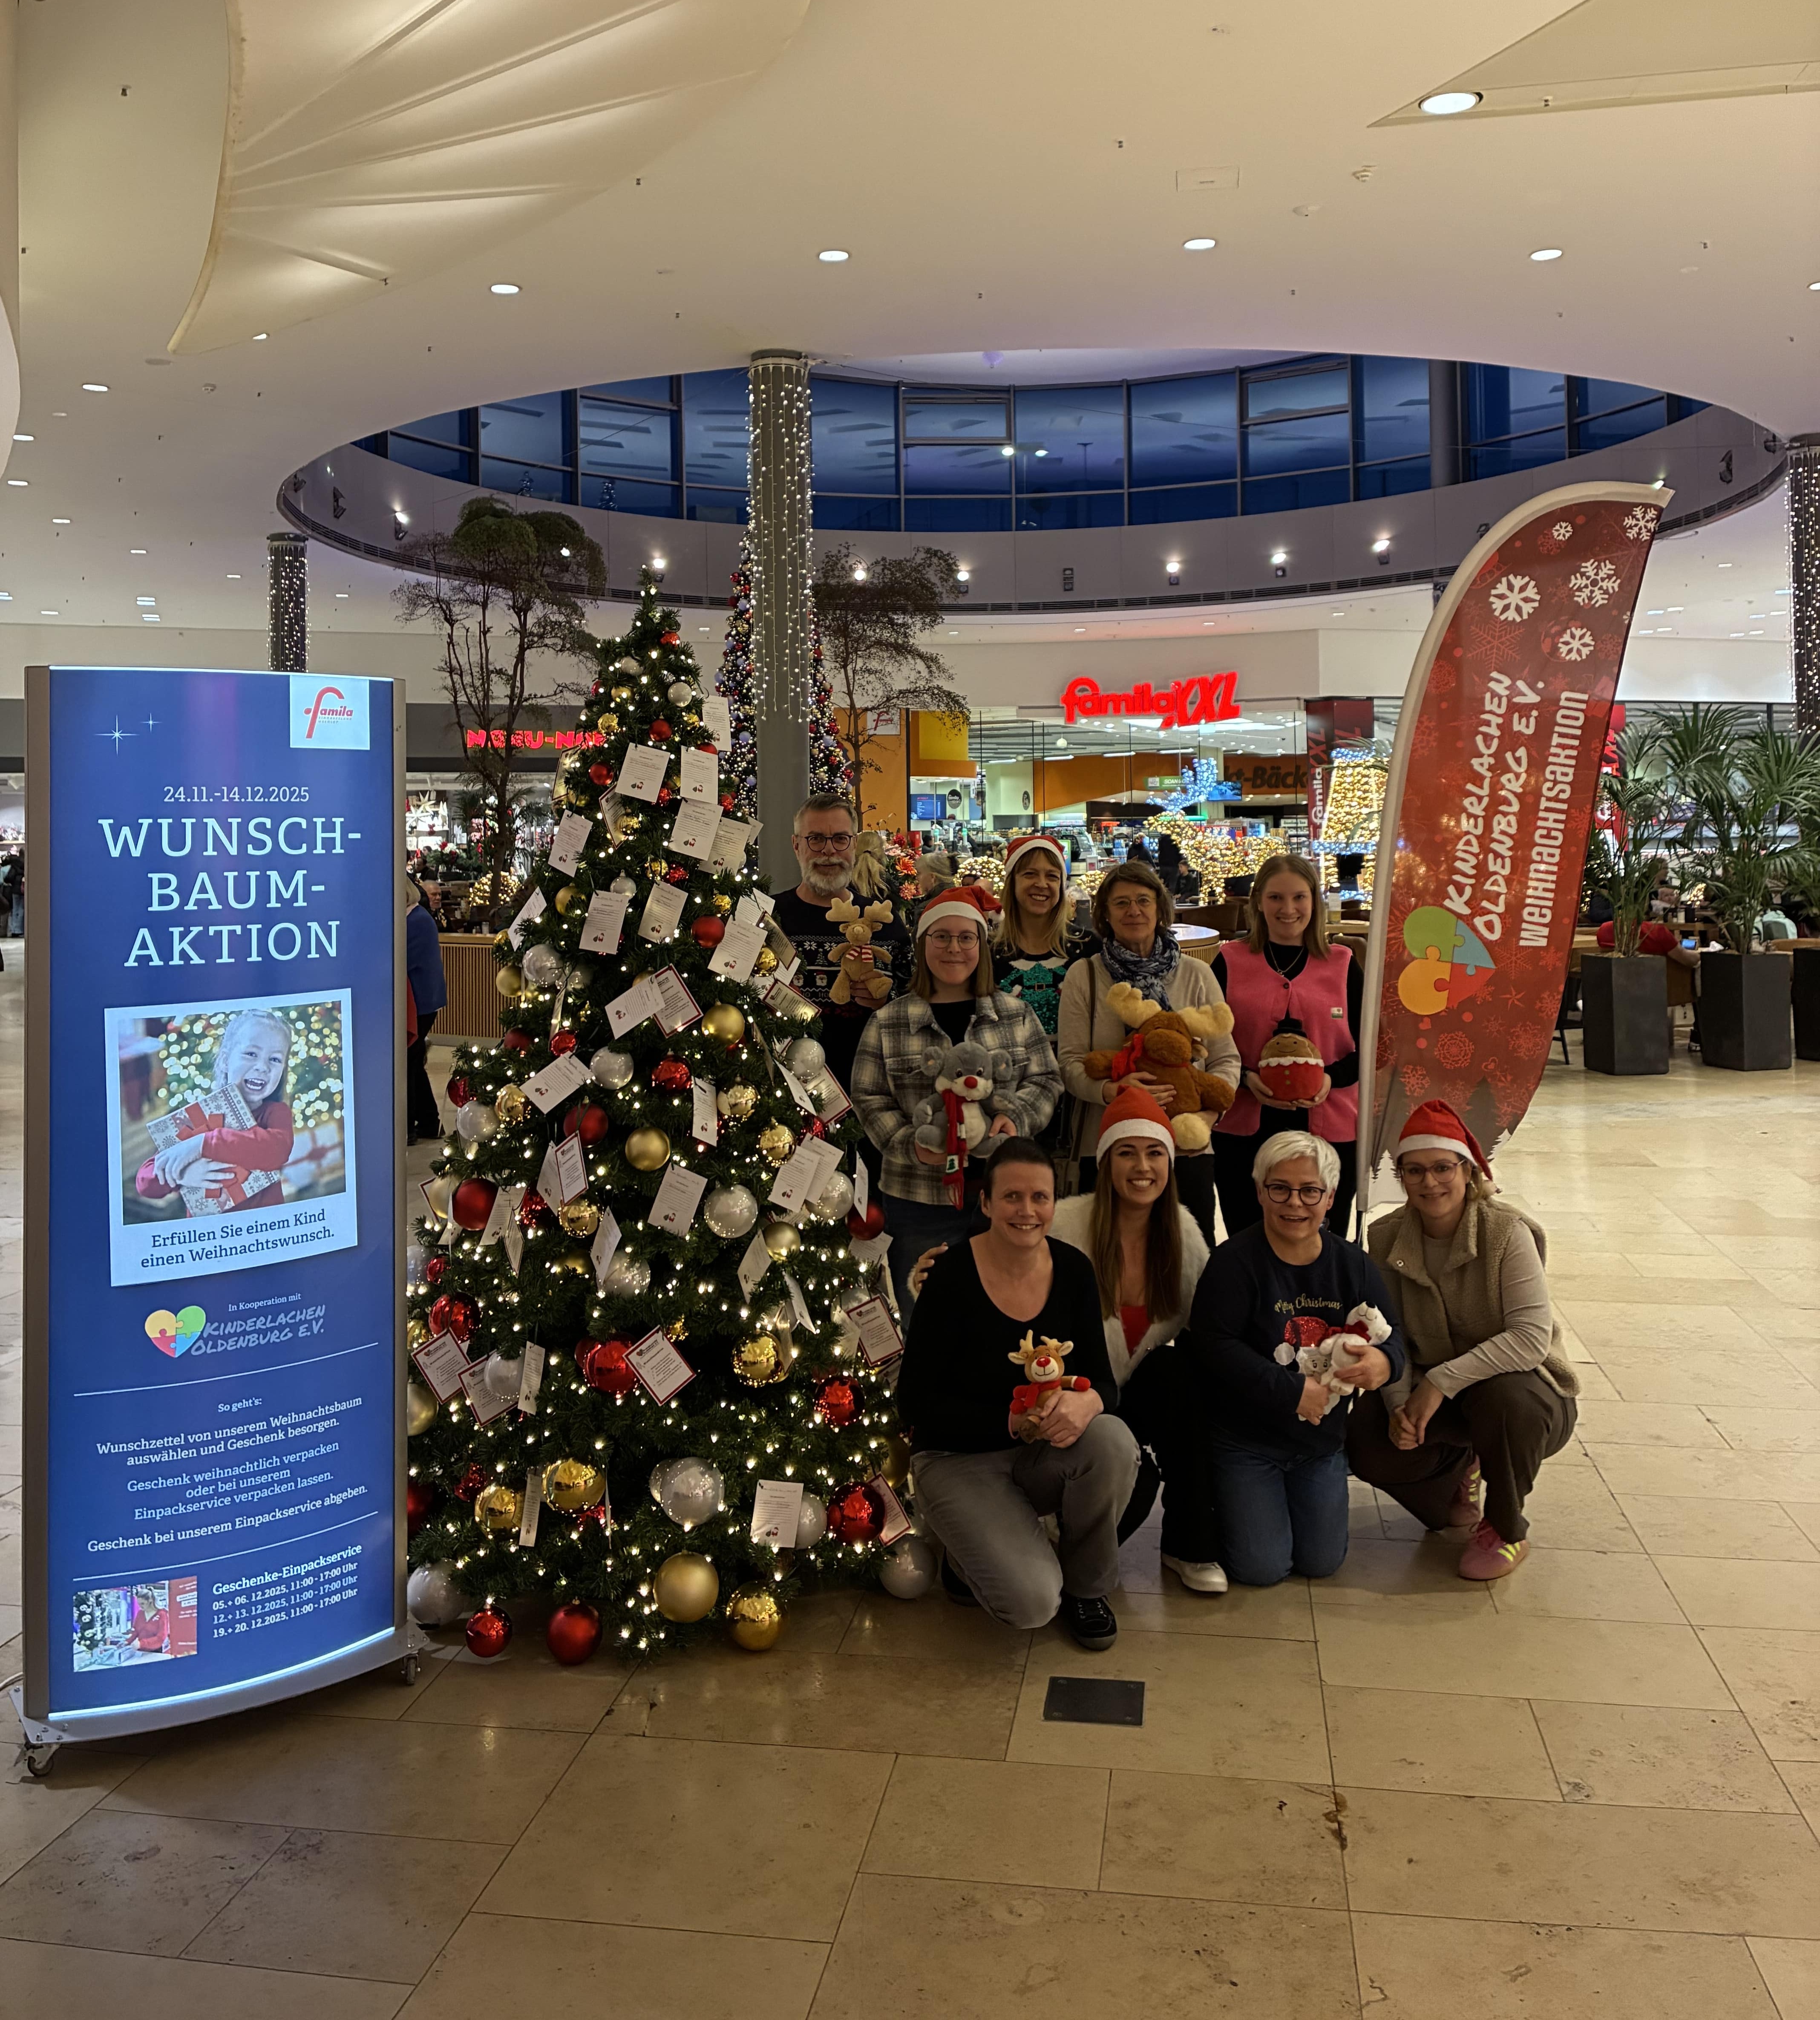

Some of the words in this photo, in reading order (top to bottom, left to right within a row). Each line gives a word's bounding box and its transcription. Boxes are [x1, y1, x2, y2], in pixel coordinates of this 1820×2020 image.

[1060, 677, 1175, 724] famila
[163, 786, 310, 803] 24.11.-14.12.2025
[1443, 671, 1512, 915] KINDERLACHEN
[1474, 746, 1528, 940] OLDENBURG
[1513, 680, 1545, 735] E.V.
[98, 816, 361, 858] WUNSCH-
[147, 870, 325, 912] BAUM-
[124, 920, 340, 967] AKTION
[141, 1253, 185, 1268] einen
[189, 1226, 335, 1262] Weihnachtswunsch.
[151, 1230, 216, 1248] Erfüllen
[220, 1224, 243, 1239] Sie
[246, 1218, 290, 1235] einem
[293, 1208, 326, 1227] Kind
[203, 1305, 325, 1338] KINDERLACHEN
[228, 1303, 238, 1311] In
[239, 1296, 287, 1311] Kooperation
[288, 1293, 302, 1302] mit
[1295, 1293, 1343, 1310] Christmas
[191, 1328, 293, 1356] OLDENBURG
[298, 1319, 324, 1337] E.V.
[96, 1433, 185, 1454] Wunschzettel
[187, 1432, 212, 1443] von
[214, 1421, 267, 1439] unserem
[269, 1397, 362, 1427] Weihnachtsbaum
[218, 1403, 230, 1412] So
[231, 1397, 262, 1412] geht's:
[127, 1448, 197, 1466] auswählen
[200, 1441, 225, 1455] und
[227, 1429, 285, 1450] Geschenk
[288, 1418, 340, 1438] besorgen.
[127, 1473, 191, 1492] Geschenk
[193, 1455, 281, 1483] weihnachtlich
[282, 1442, 340, 1462] verpacken
[186, 1485, 216, 1498] oder
[218, 1478, 237, 1492] bei
[239, 1469, 291, 1488] unserem
[134, 1496, 231, 1521] Einpackservice
[233, 1484, 295, 1503] verpacken
[297, 1472, 334, 1489] lassen.
[87, 1534, 152, 1552] Geschenk
[155, 1530, 175, 1543] bei
[177, 1522, 233, 1540] unserem
[235, 1499, 322, 1529] Einpackservice
[324, 1485, 368, 1506] abgeben.
[212, 1545, 362, 1595] Geschenke-Einpackservice
[290, 1576, 314, 1591] 11:00
[319, 1567, 341, 1582] 17:00
[342, 1562, 358, 1573] Uhr
[290, 1590, 314, 1605] 11:00
[319, 1580, 341, 1595] 17:00
[342, 1576, 358, 1587] Uhr
[290, 1603, 314, 1618] 11:00
[319, 1594, 341, 1608] 17:00
[342, 1588, 358, 1600] Uhr
